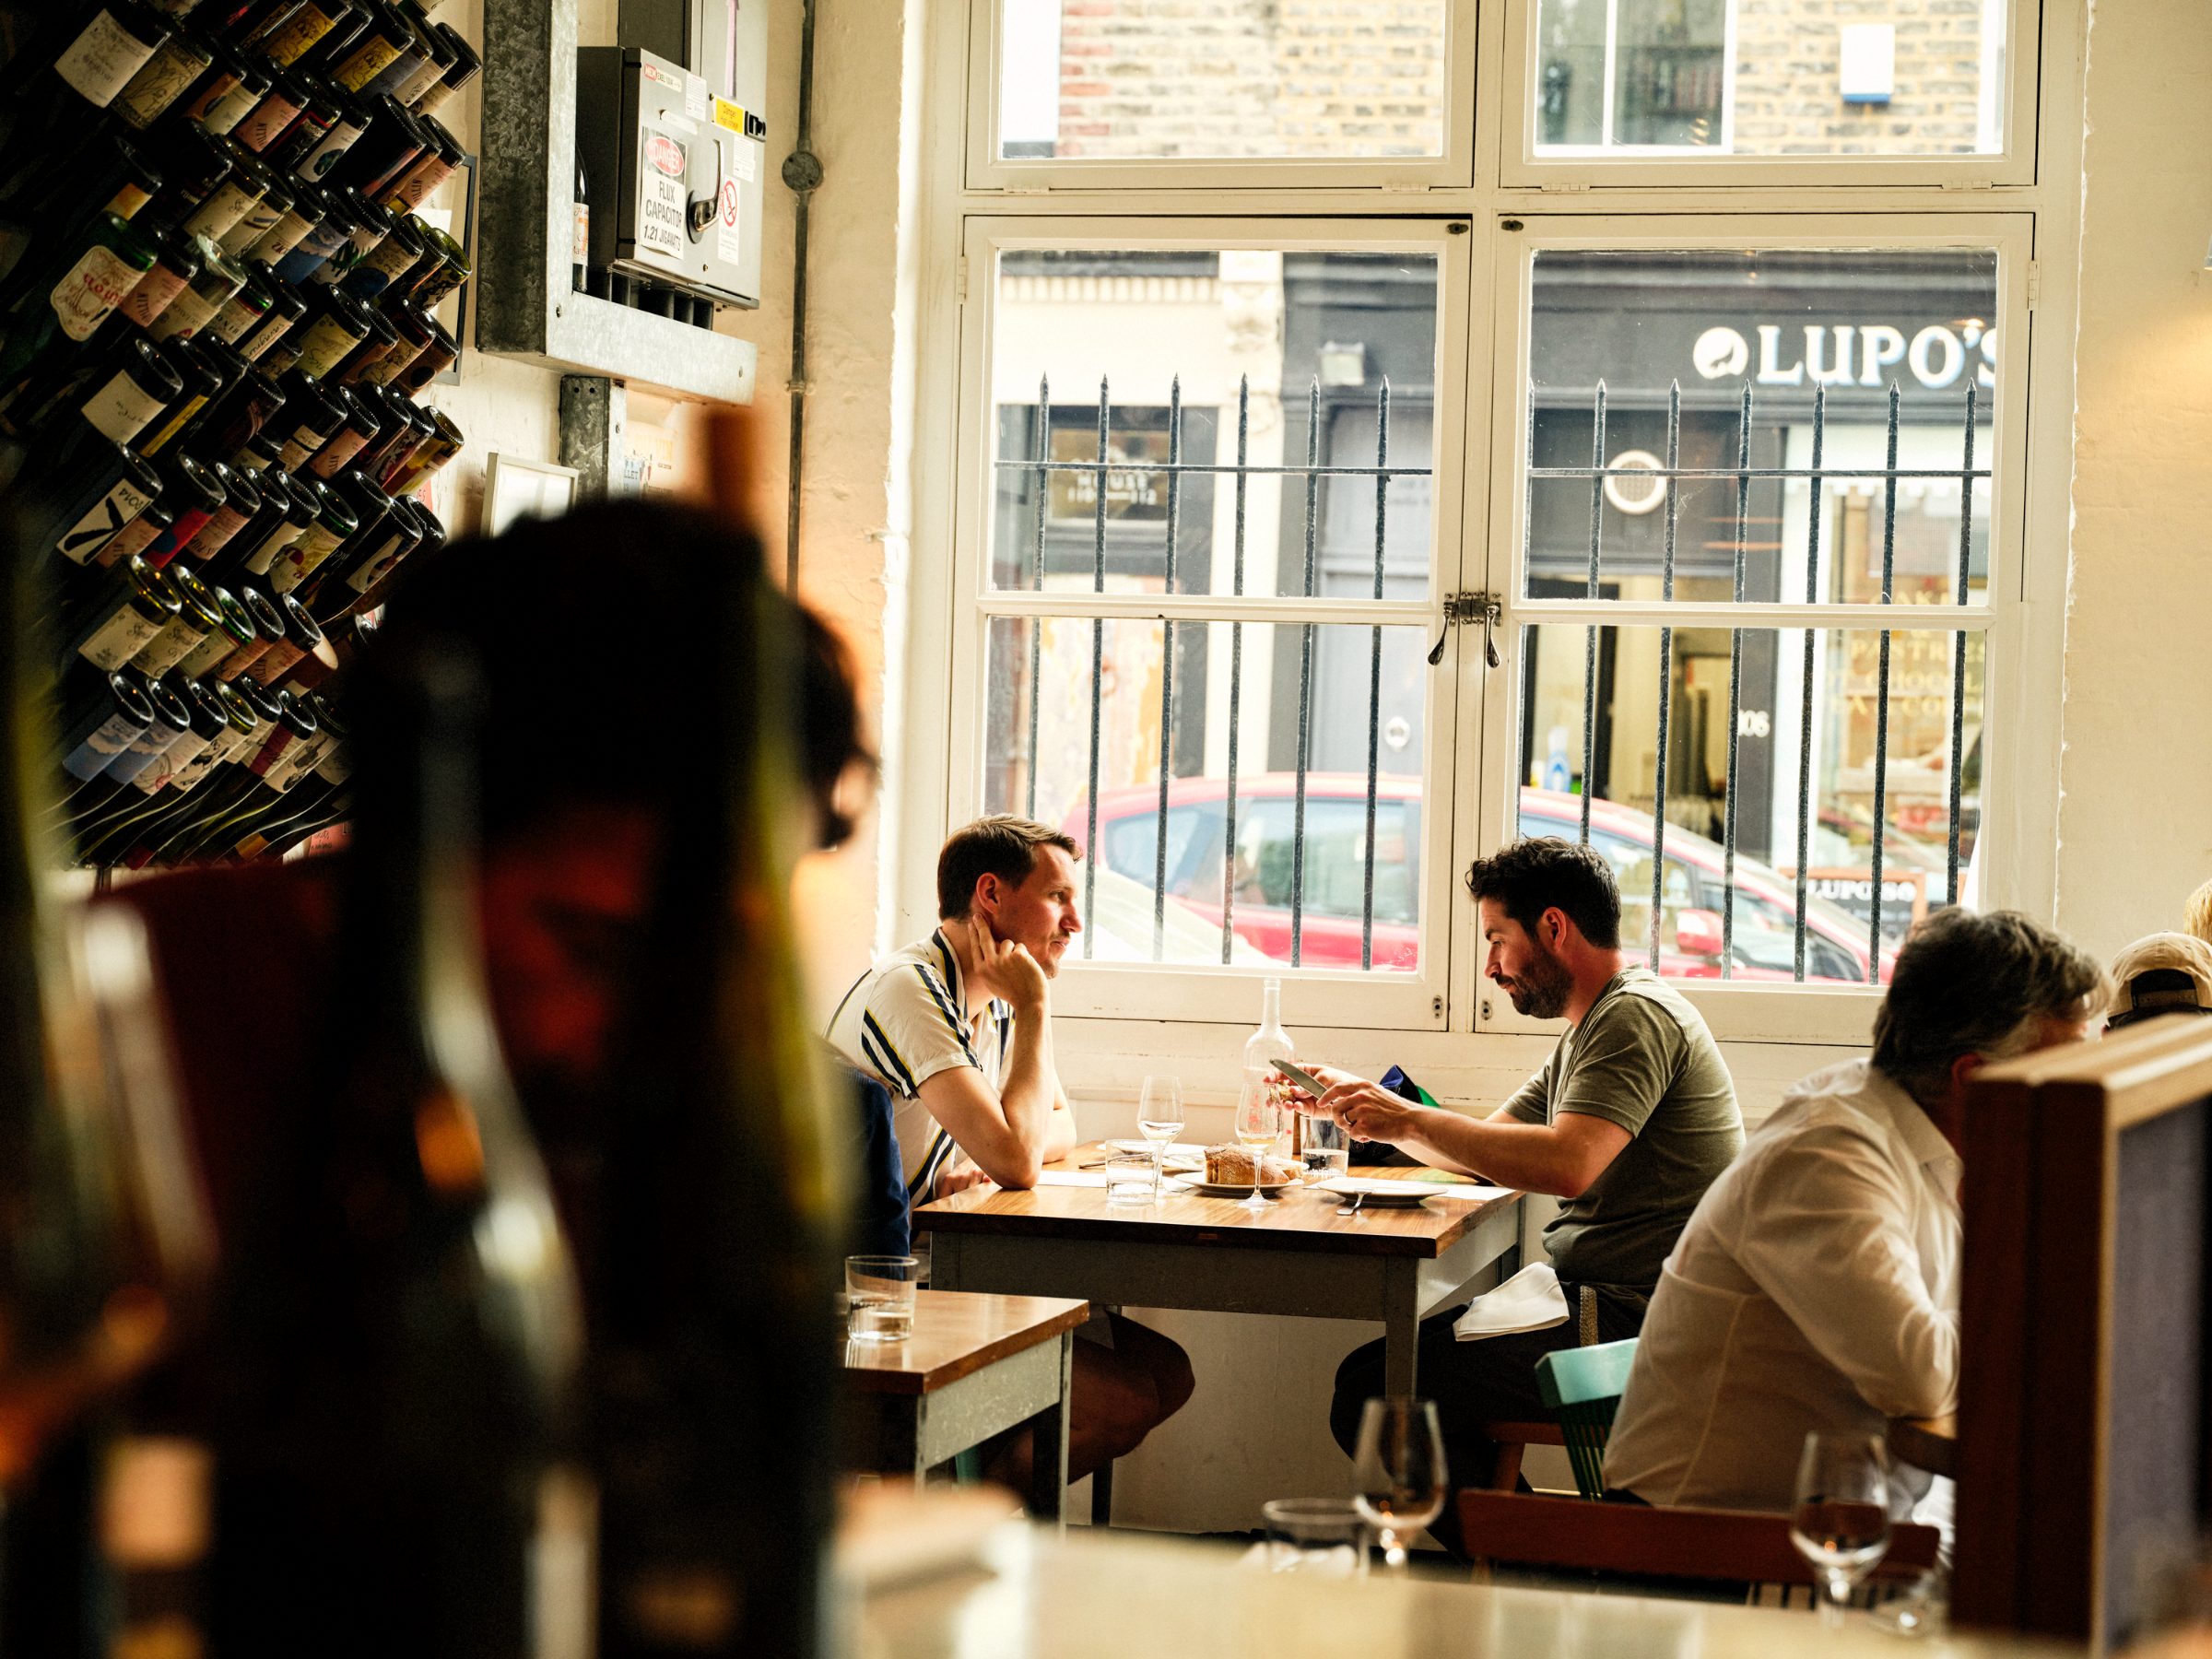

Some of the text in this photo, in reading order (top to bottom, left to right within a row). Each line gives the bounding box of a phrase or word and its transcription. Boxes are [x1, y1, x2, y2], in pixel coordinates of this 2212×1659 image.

[653, 143, 680, 172] DANGER
[659, 181, 676, 204] FLUX
[645, 198, 682, 229] CAPACITOR
[643, 224, 658, 241] 1.21
